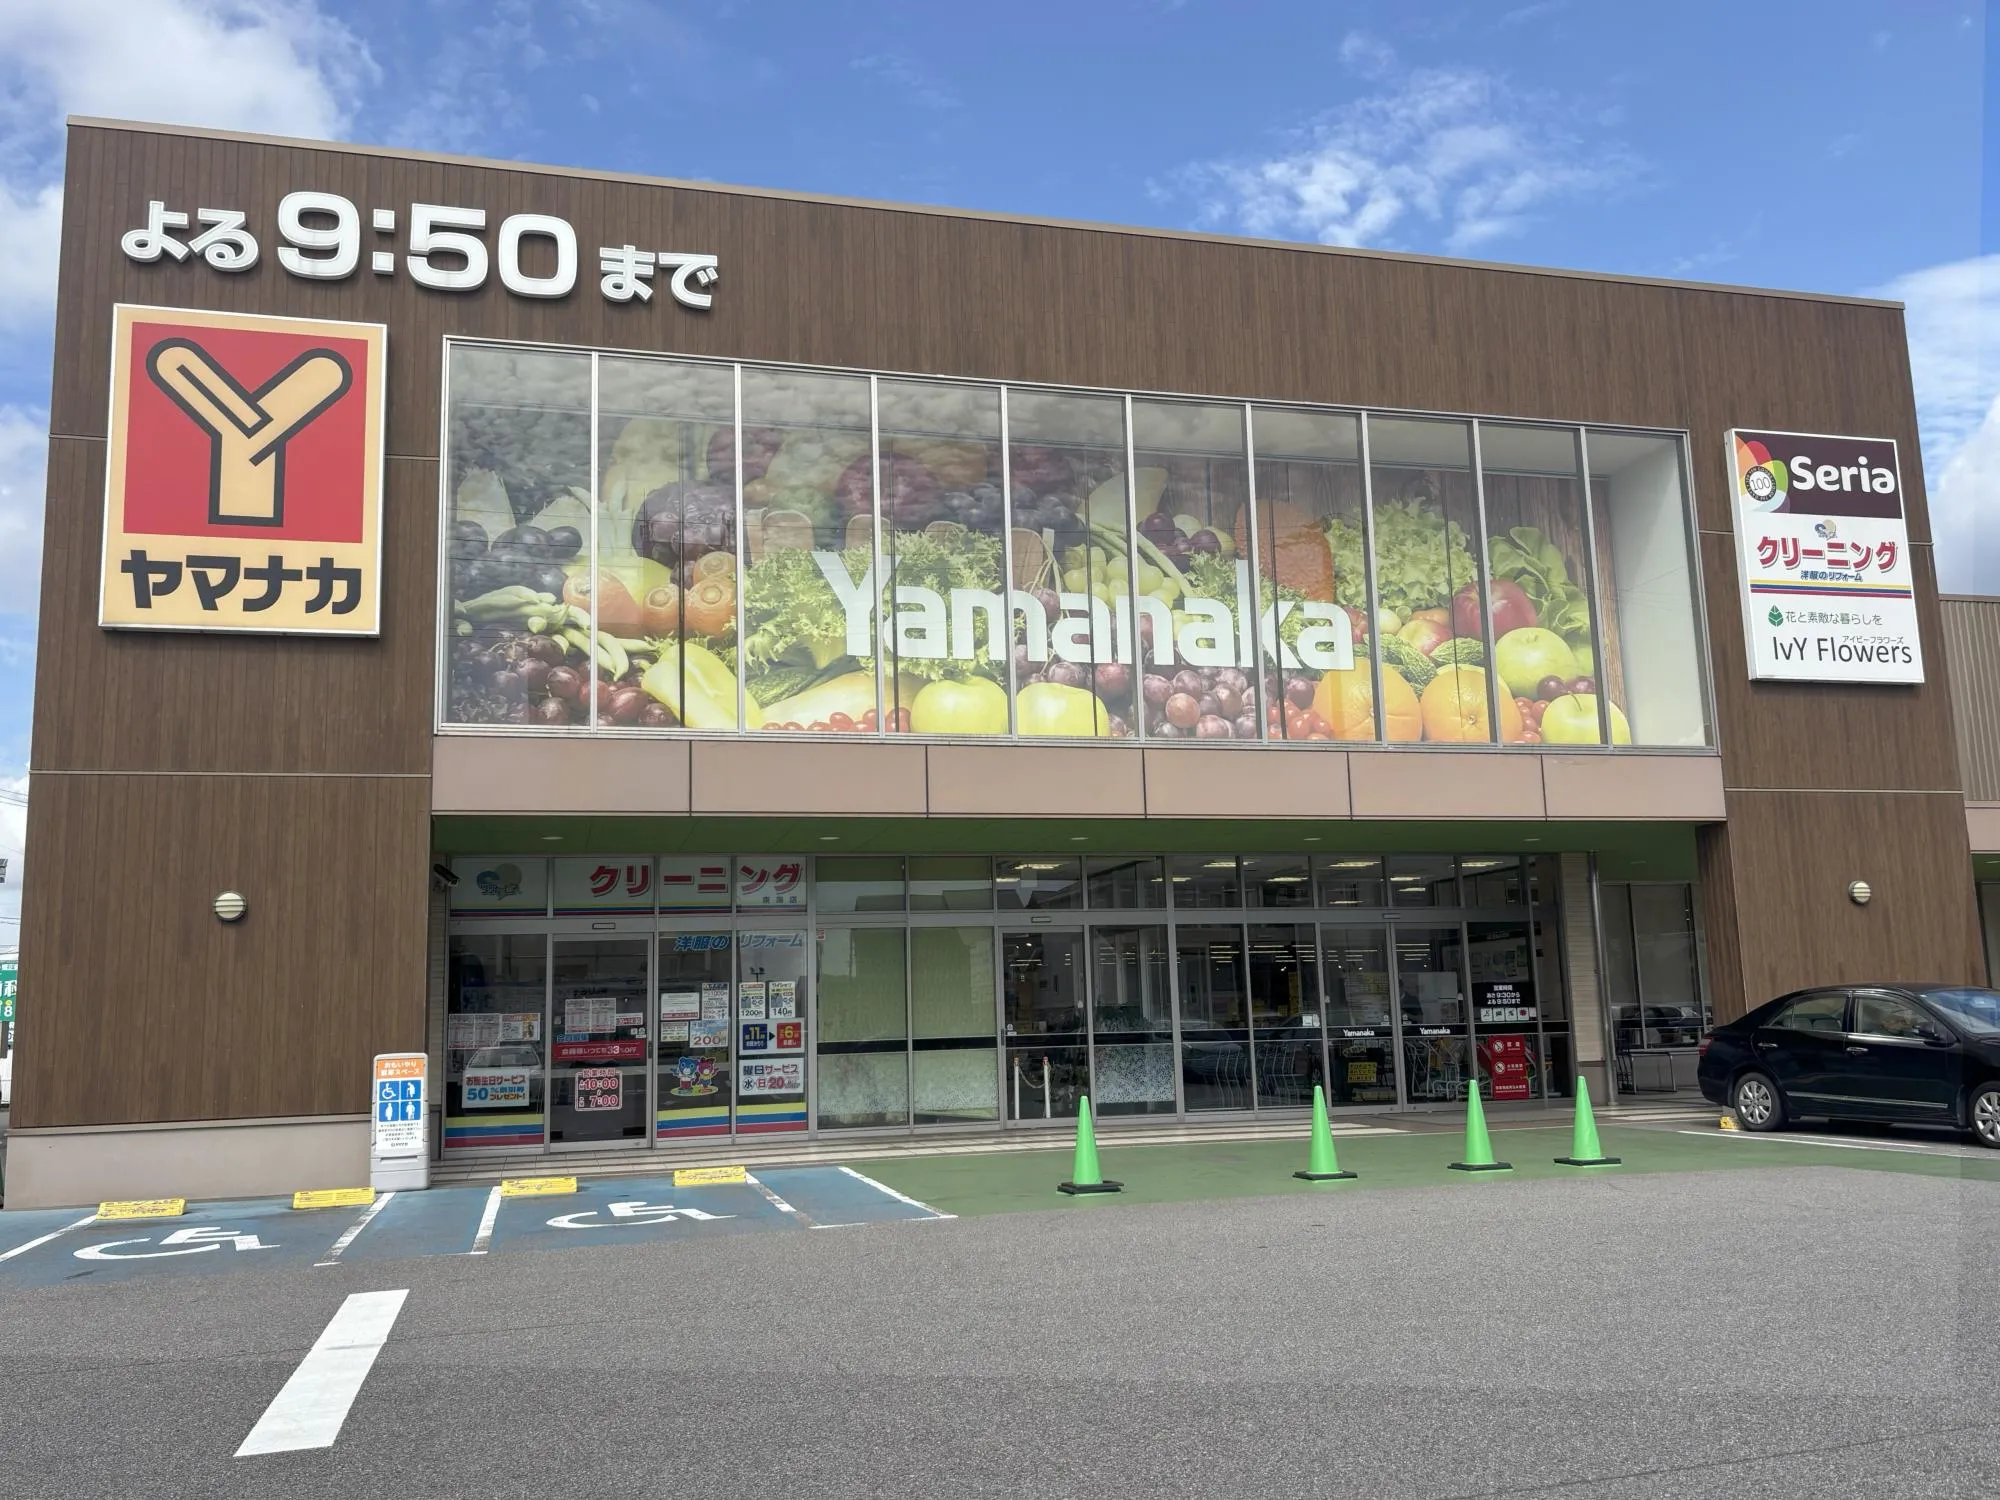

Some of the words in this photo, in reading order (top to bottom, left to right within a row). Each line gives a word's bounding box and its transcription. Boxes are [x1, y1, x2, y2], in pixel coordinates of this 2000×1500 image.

[120, 190, 720, 311] よる9:50まで
[1790, 455, 1896, 494] Seria
[1751, 476, 1771, 491] 100
[1757, 536, 1898, 573] クリーニング
[120, 549, 363, 615] ヤマナカ
[1800, 569, 1864, 583] 洋服のリフォーム
[810, 550, 1356, 671] Yamanaka
[1785, 611, 1883, 626] 花と素敵な暮らしを
[1842, 635, 1905, 645] アイビーフラワーズ
[1817, 637, 1913, 664] Flowers
[590, 864, 802, 898] クリーニング
[674, 933, 803, 951] 洋服のリフォーム
[1343, 1028, 1375, 1037] Yamanaka
[1420, 1026, 1451, 1035] Yamanaka
[585, 1078, 619, 1090] 10:00
[589, 1094, 619, 1107] 7:00
